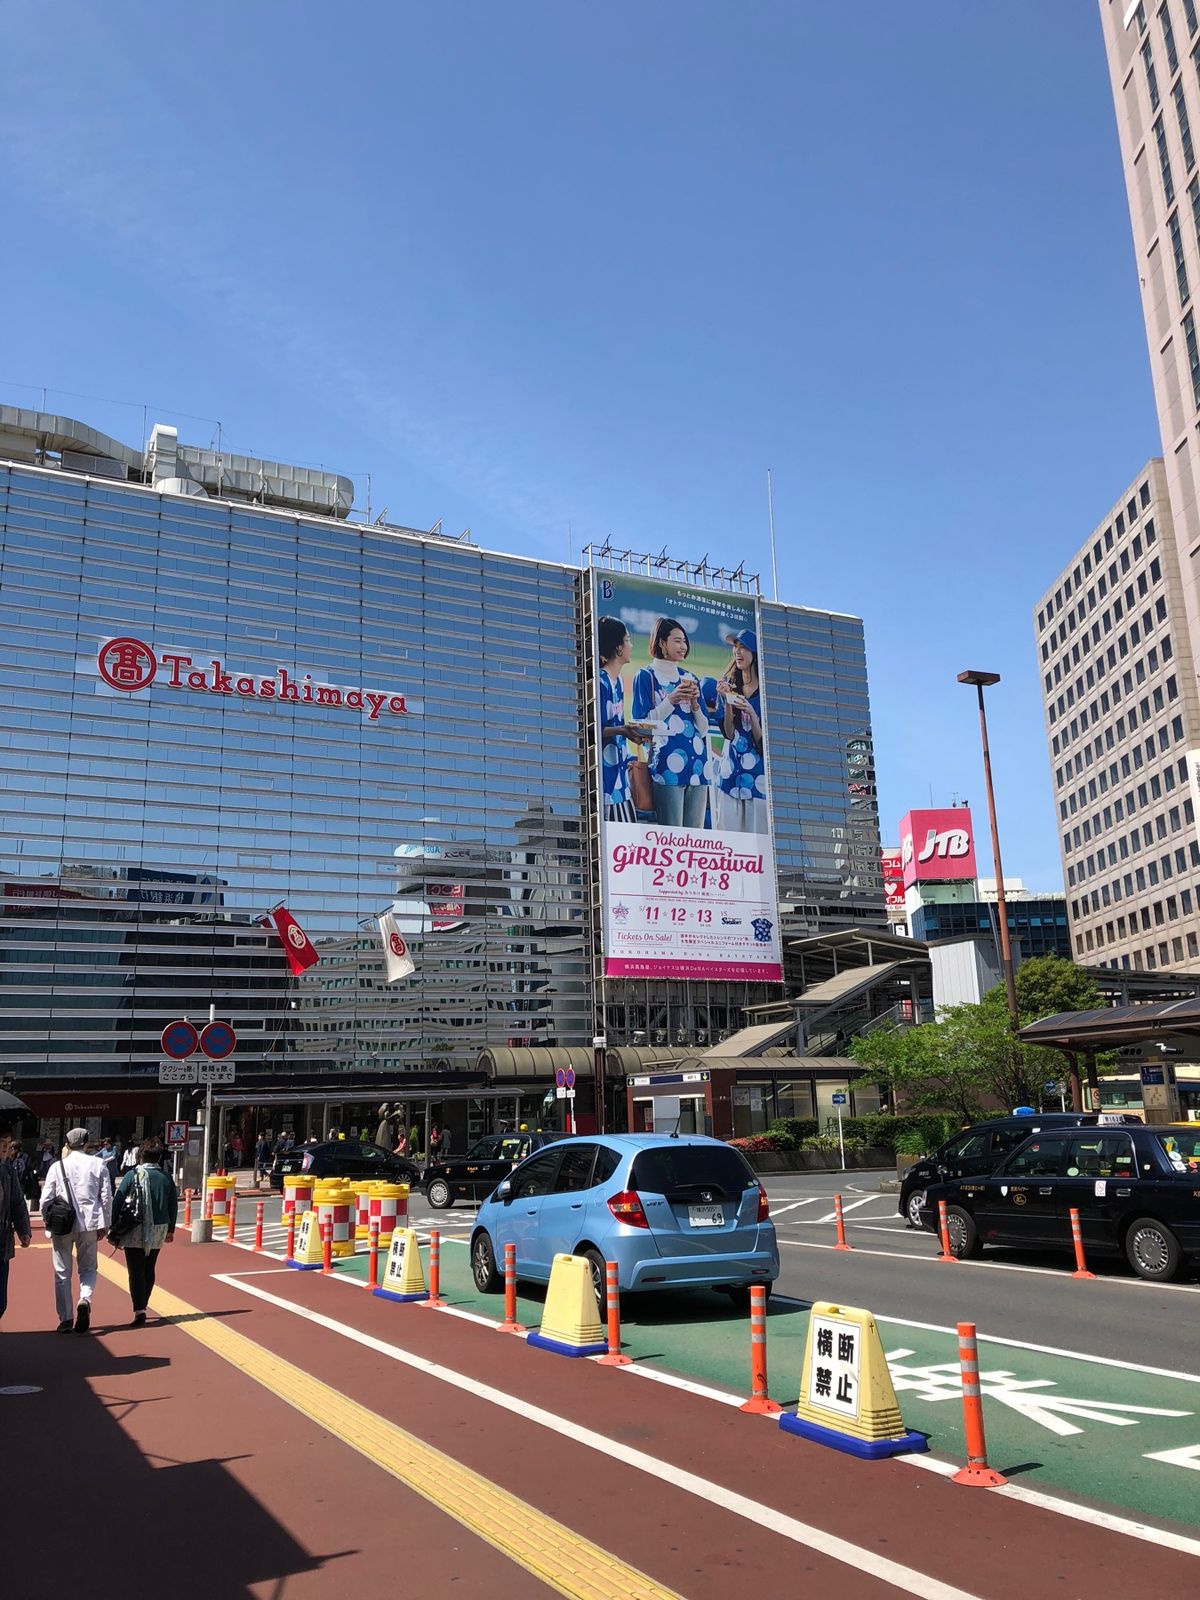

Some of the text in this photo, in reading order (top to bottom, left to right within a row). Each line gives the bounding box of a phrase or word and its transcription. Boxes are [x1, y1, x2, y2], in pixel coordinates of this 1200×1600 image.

[162, 654, 408, 719] Takashimaya
[646, 831, 732, 852] Yokohama
[918, 829, 969, 861] JTB
[677, 850, 764, 874] Festival
[646, 906, 659, 920] 11
[671, 907, 686, 921] 12
[697, 909, 712, 923] 13
[617, 932, 672, 941] Tickets On Sale!
[162, 1073, 194, 1081] ここから
[816, 1327, 855, 1364] 横断
[815, 1366, 853, 1404] 禁止
